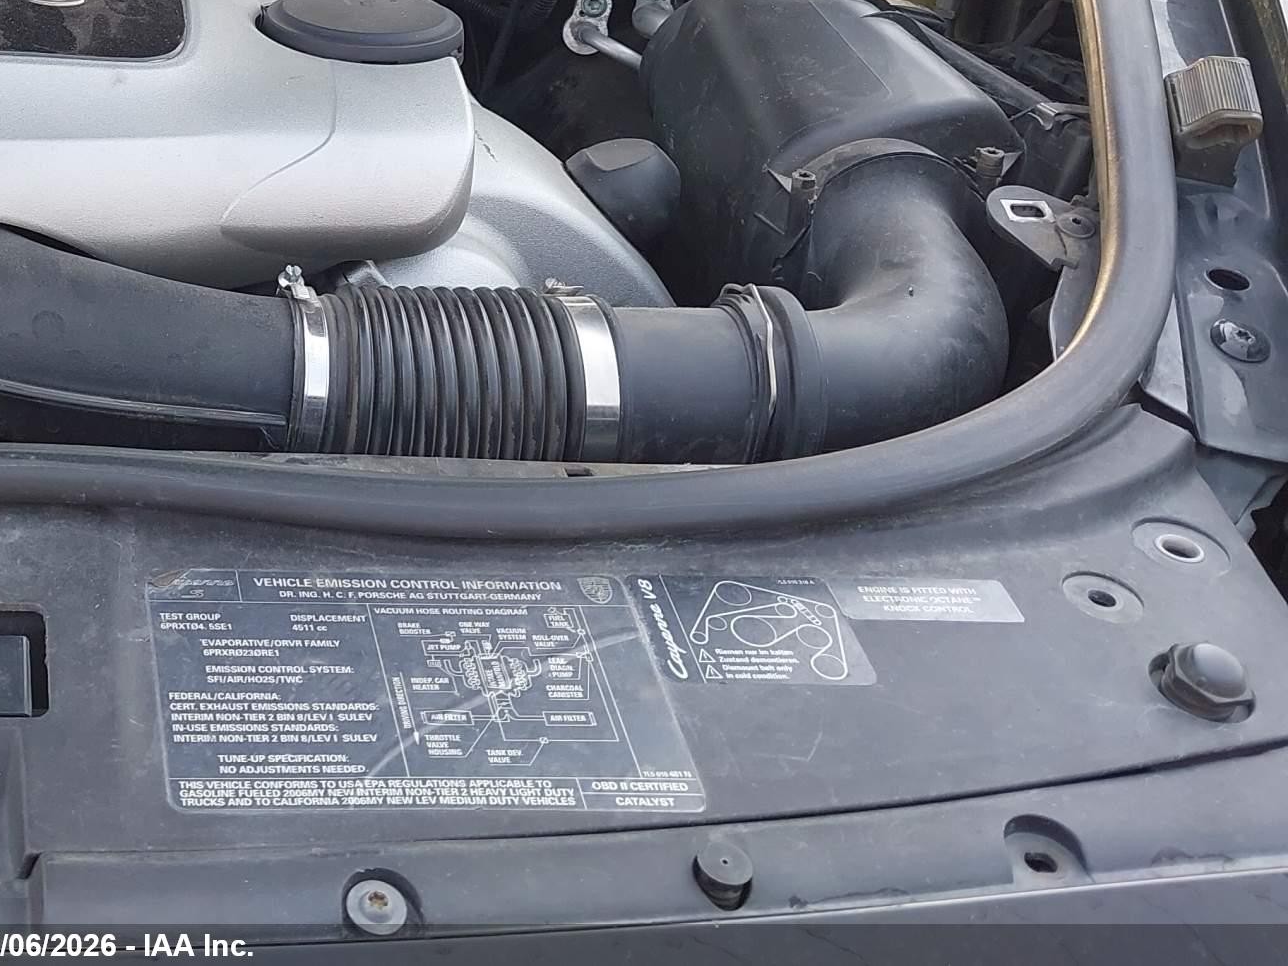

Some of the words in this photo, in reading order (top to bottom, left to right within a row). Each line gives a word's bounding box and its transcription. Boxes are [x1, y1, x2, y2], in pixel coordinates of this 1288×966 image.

[253, 578, 312, 588] VEHICLE
[316, 578, 386, 588] EMISSION
[390, 579, 460, 590] CONTROL
[462, 580, 562, 591] INFORMATION
[638, 578, 657, 600] V8
[857, 586, 898, 594] ENGINE
[899, 586, 910, 594] IS
[912, 586, 947, 594] FITTED
[280, 590, 296, 598] DR.
[338, 591, 347, 599] C.
[359, 592, 408, 600] PORSCHE
[410, 592, 425, 600] AG
[485, 608, 528, 616] DIAGRAM
[290, 614, 366, 622] DISPLACEMENT
[304, 640, 340, 648] FAMILY
[650, 602, 688, 679] Cayenne
[206, 665, 256, 673] EMISSION
[310, 666, 354, 674] SYSTEM:
[172, 724, 208, 732] IN-USE
[210, 724, 268, 732] EMISSIONS
[174, 734, 216, 742] INTERIM
[219, 734, 269, 742] NON-TIER
[271, 734, 277, 742] 2
[280, 734, 298, 742] BIN
[342, 734, 378, 742] SULEV
[217, 754, 266, 762] TUNE-UP
[219, 766, 236, 774] NO
[239, 766, 320, 774] ADJUSTMENTS
[179, 781, 204, 789] THIS
[206, 781, 252, 789] VEHICLE
[254, 781, 318, 789] CONFORMS
[320, 780, 336, 788] TO
[338, 780, 361, 788] USA
[364, 780, 386, 788] EPA
[388, 780, 467, 788] REGULATIONS
[470, 780, 532, 788] APPLICABLE
[534, 780, 552, 788] TO
[592, 782, 617, 792] OBD
[629, 782, 689, 792] CERTIFIED
[180, 789, 236, 797] GASOLINE
[238, 789, 280, 797] FUELED
[328, 789, 354, 797] NEW
[357, 788, 404, 796] INTERIM
[405, 788, 460, 796] NON-TIER
[462, 788, 468, 796] 2
[472, 788, 508, 796] HEAVY
[511, 788, 543, 796] LIGHT
[546, 788, 574, 797] DUTY
[180, 798, 226, 806] TRUCKS
[227, 798, 253, 806] AND
[255, 798, 272, 806] TO
[273, 797, 339, 806] CALIFORNIA
[386, 797, 413, 806] NEW
[415, 797, 437, 806] LEV
[440, 796, 488, 805] MEDIUM
[489, 796, 519, 806] DUTY
[522, 797, 576, 806] VEHICLES
[615, 797, 675, 806] CATALYST
